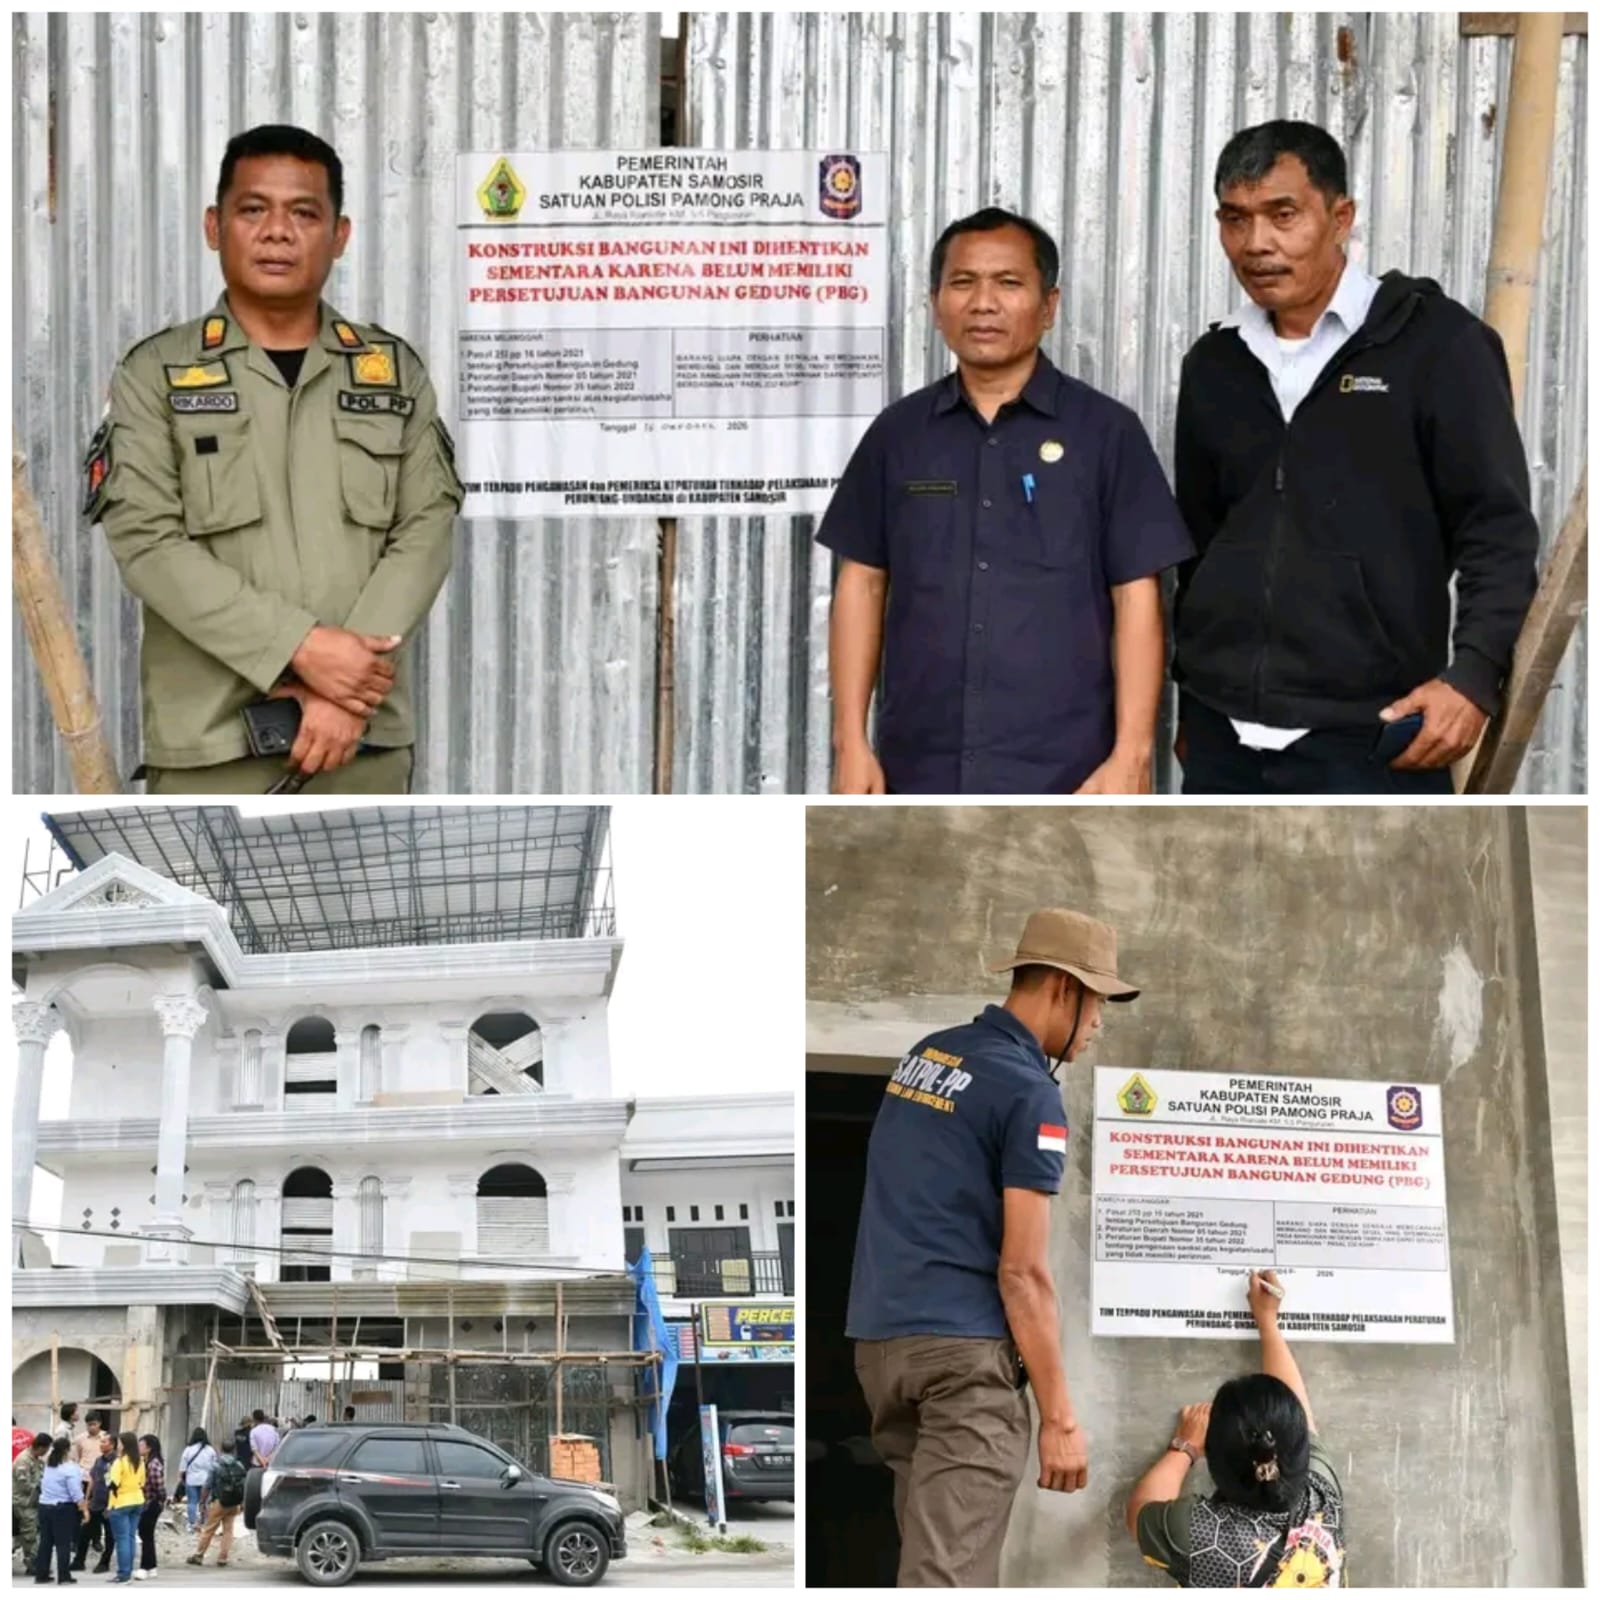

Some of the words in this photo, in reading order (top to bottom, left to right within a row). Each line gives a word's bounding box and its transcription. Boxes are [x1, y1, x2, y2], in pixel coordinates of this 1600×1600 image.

[617, 156, 728, 171] PEMERINTAH
[580, 174, 683, 189] KABUPATEN
[688, 174, 764, 189] SAMOSIR
[540, 193, 606, 209] SATUAN
[611, 192, 666, 208] POLISI
[671, 192, 745, 208] PAMONG
[750, 192, 805, 208] PRAJA
[468, 242, 595, 258] KONSTRUKSI
[599, 240, 715, 256] BANGUNAN
[719, 240, 748, 256] INI
[753, 240, 869, 256] DIHENTIKAN
[487, 264, 604, 280] SEMENTARA
[608, 263, 696, 278] KARENA
[702, 262, 765, 278] BELUM
[768, 262, 853, 278] MEMILIKI
[469, 286, 609, 302] PERSETUJUAN
[613, 285, 730, 300] BANGUNAN
[735, 285, 812, 300] GEDUNG
[816, 285, 869, 304] (PBG)
[1229, 1078, 1312, 1093] PEMERINTAH
[1200, 1090, 1279, 1104] KABUPATEN
[1282, 1094, 1342, 1107] SAMOSIR
[1168, 1101, 1221, 1113] SATUAN
[1225, 1103, 1267, 1116] POLISI
[1271, 1106, 1327, 1119] PAMONG
[1330, 1109, 1374, 1121] PRAJA
[1110, 1132, 1211, 1147] KONSTRUKSI
[1215, 1136, 1304, 1151] BANGUNAN
[1307, 1141, 1330, 1153] INI
[1334, 1142, 1430, 1156] DIHENTIKAN
[1123, 1148, 1220, 1163] SEMENTARA
[1223, 1152, 1289, 1166] KARENA
[1293, 1156, 1344, 1168] BELUM
[1347, 1158, 1417, 1171] MEMILIKI
[1110, 1164, 1224, 1179] PERSETUJUAN
[1228, 1168, 1317, 1182] BANGUNAN
[1320, 1173, 1384, 1185] GEDUNG
[1388, 1175, 1431, 1190] (PBG)
[735, 1308, 794, 1325] PERCE
[1100, 1307, 1114, 1317] TIM
[1116, 1308, 1150, 1318] TERPADU
[1152, 1308, 1205, 1319] PENGAWASAN
[1206, 1310, 1221, 1319] dan
[1312, 1312, 1350, 1322] TERHADAP
[1404, 1315, 1446, 1325] PERATURAN
[1287, 1321, 1330, 1331] KABUPATEN
[1331, 1323, 1366, 1332] SAMOSIR
